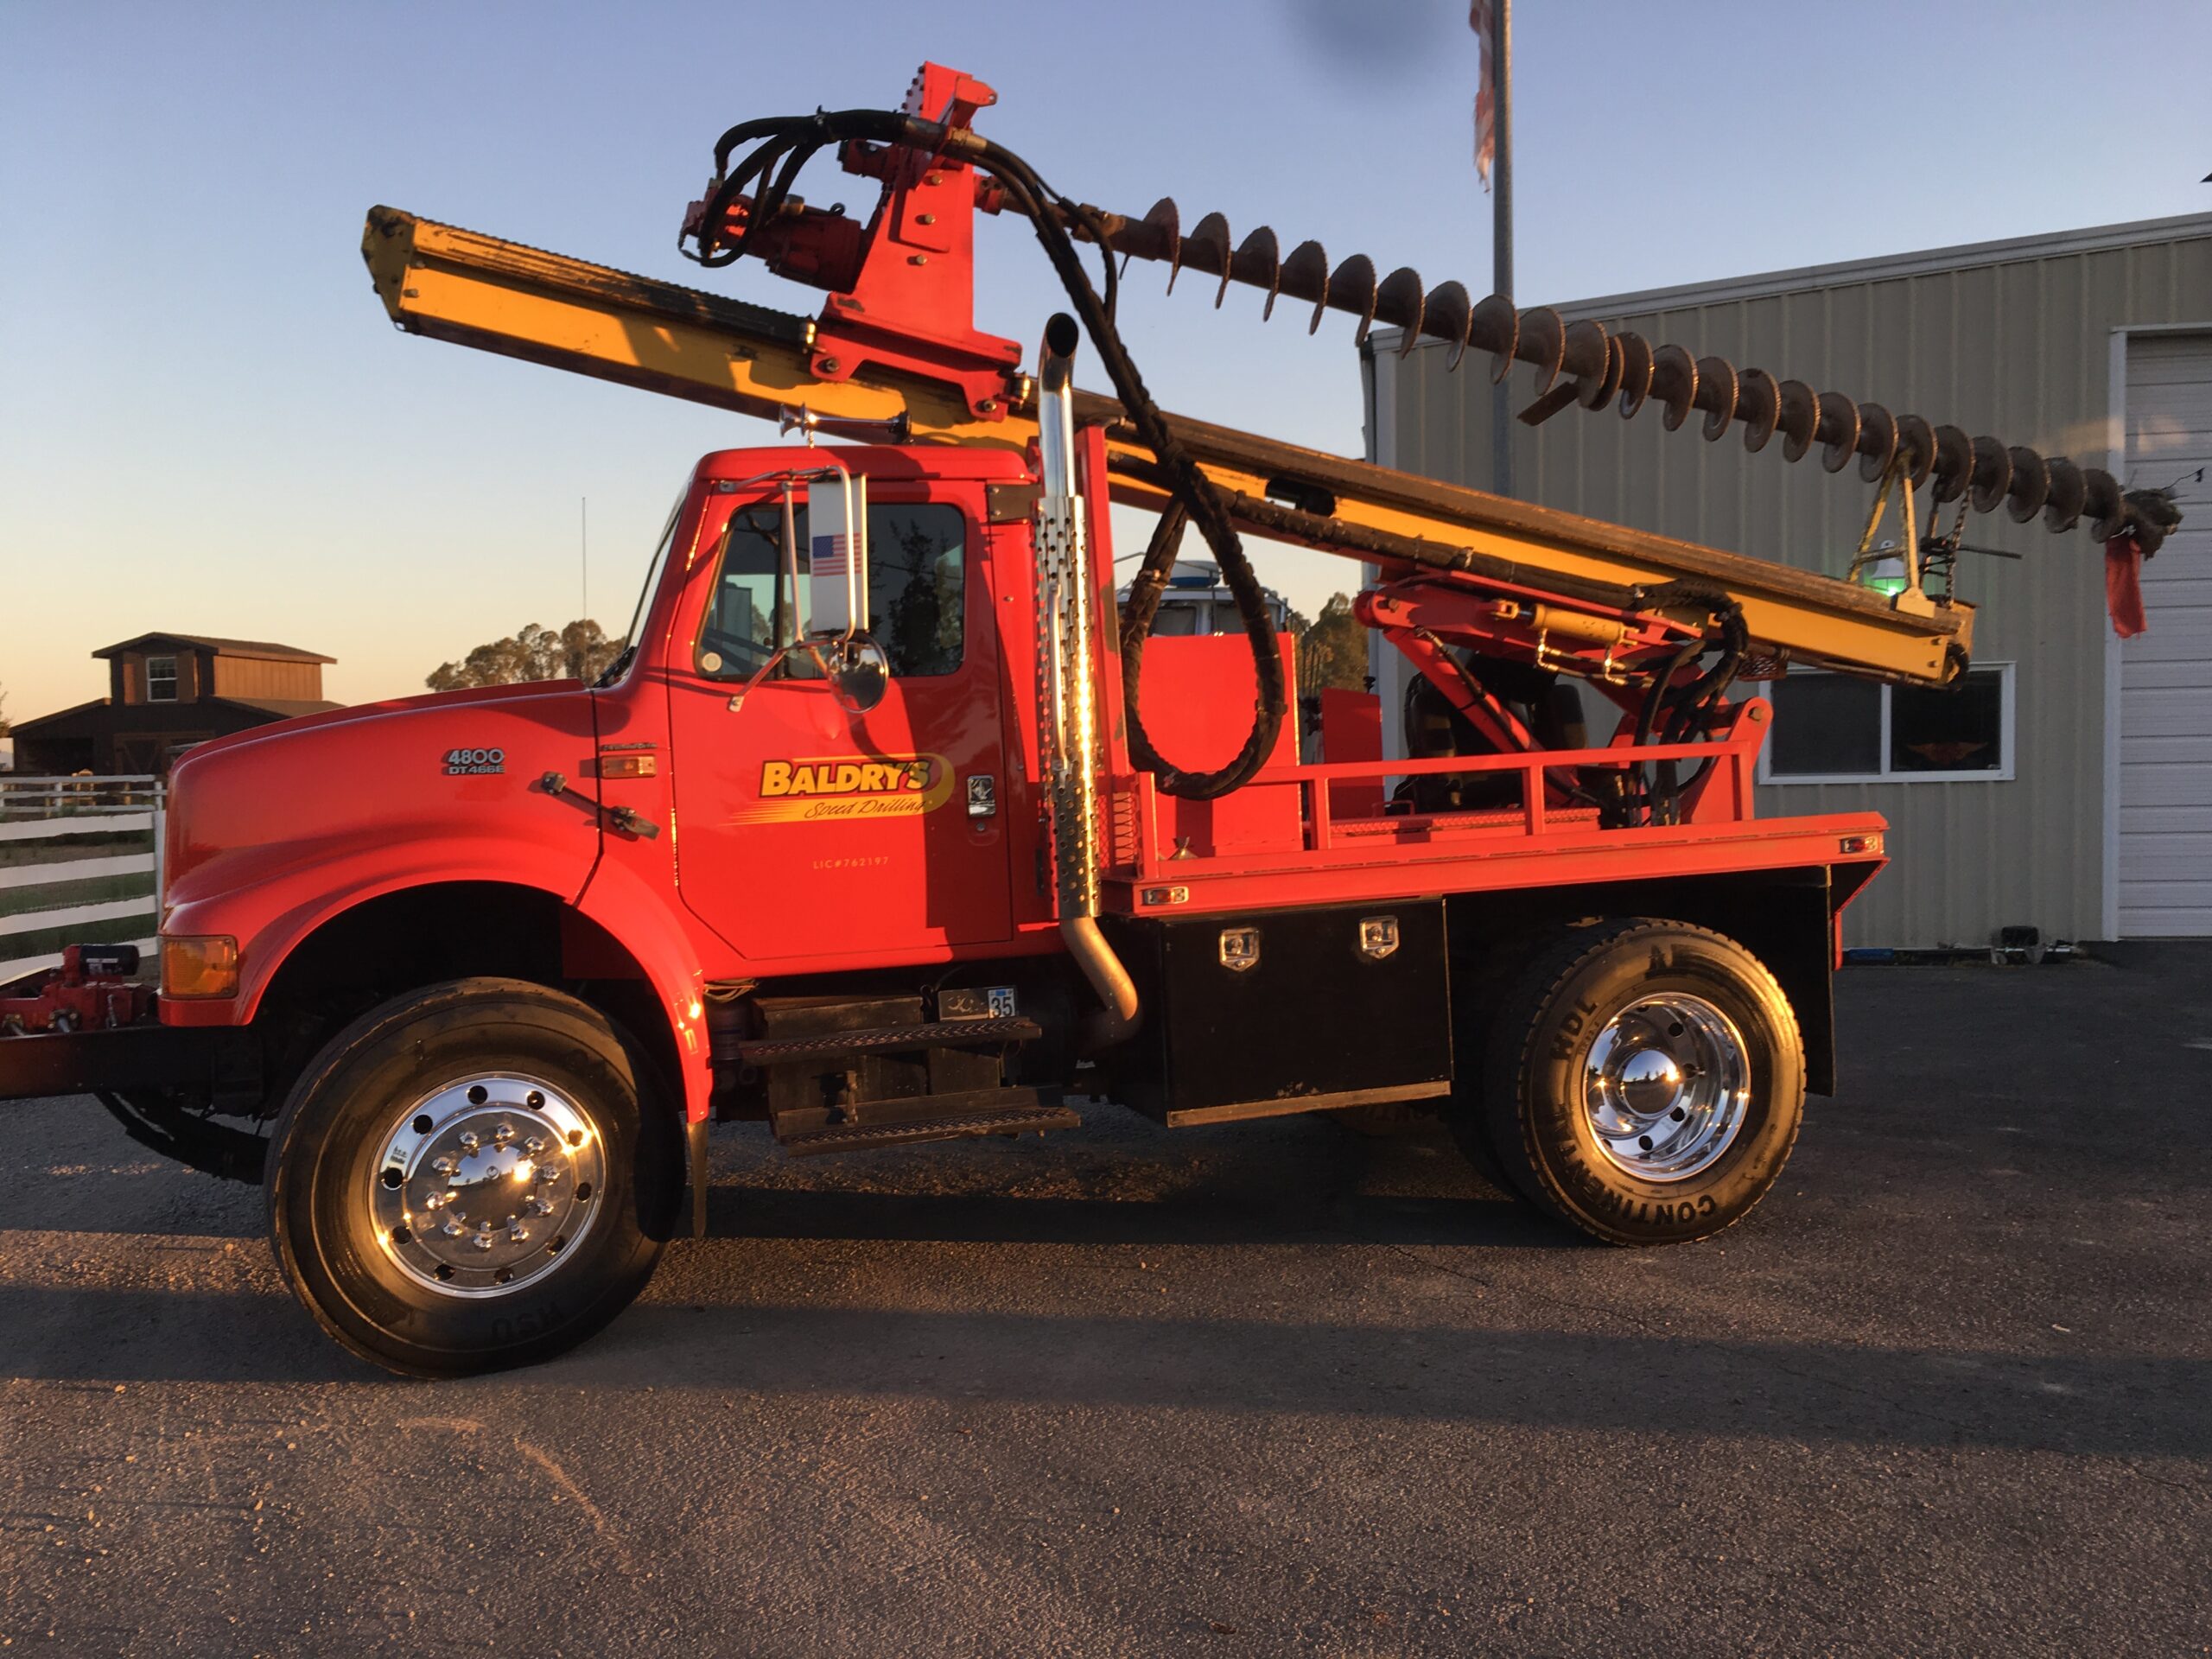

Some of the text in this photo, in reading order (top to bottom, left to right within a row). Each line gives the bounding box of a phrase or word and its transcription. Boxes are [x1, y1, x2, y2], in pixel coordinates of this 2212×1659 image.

[448, 748, 505, 765] 4800
[760, 760, 931, 798] BALDRY'S
[804, 798, 926, 819] Speed Drilling
[991, 997, 1013, 1017] 35
